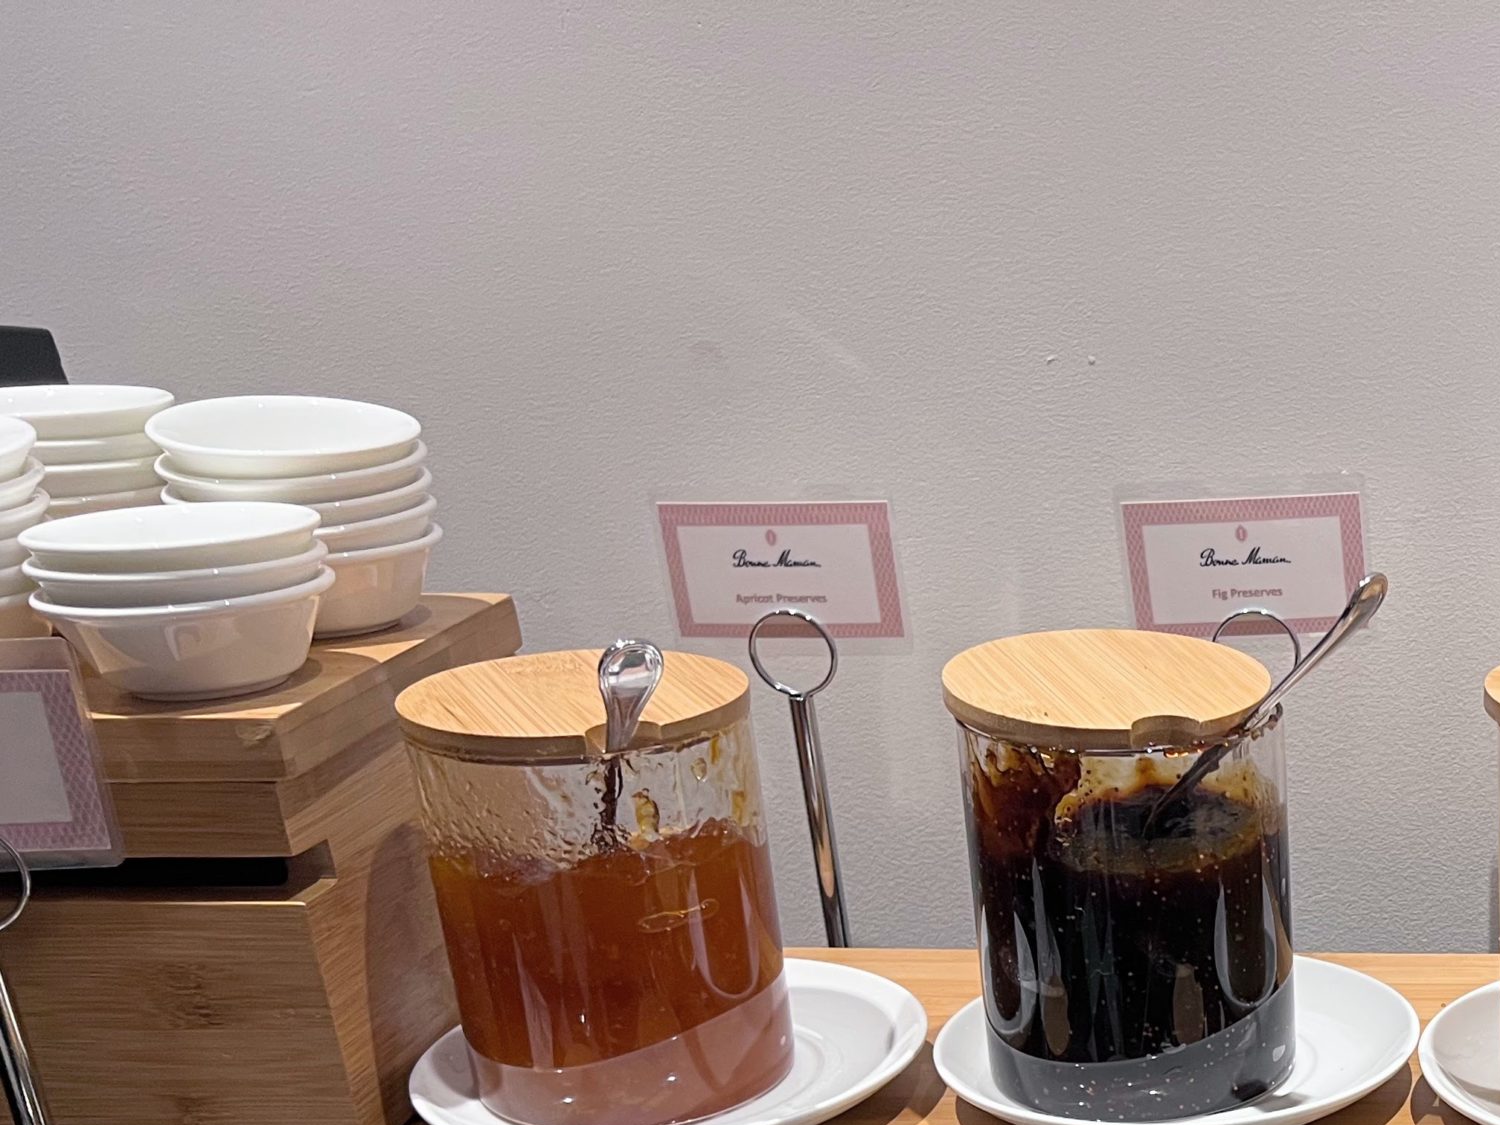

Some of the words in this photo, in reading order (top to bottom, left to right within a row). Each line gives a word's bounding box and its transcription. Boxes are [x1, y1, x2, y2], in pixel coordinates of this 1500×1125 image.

[732, 549, 771, 568] Bonne
[772, 549, 822, 568] Maman
[1200, 547, 1239, 567] Bonne
[1241, 546, 1292, 565] Maman
[736, 593, 774, 605] Apricot
[776, 593, 828, 603] Preserves
[1211, 589, 1228, 601] Fig
[1230, 588, 1283, 598] Preserves
